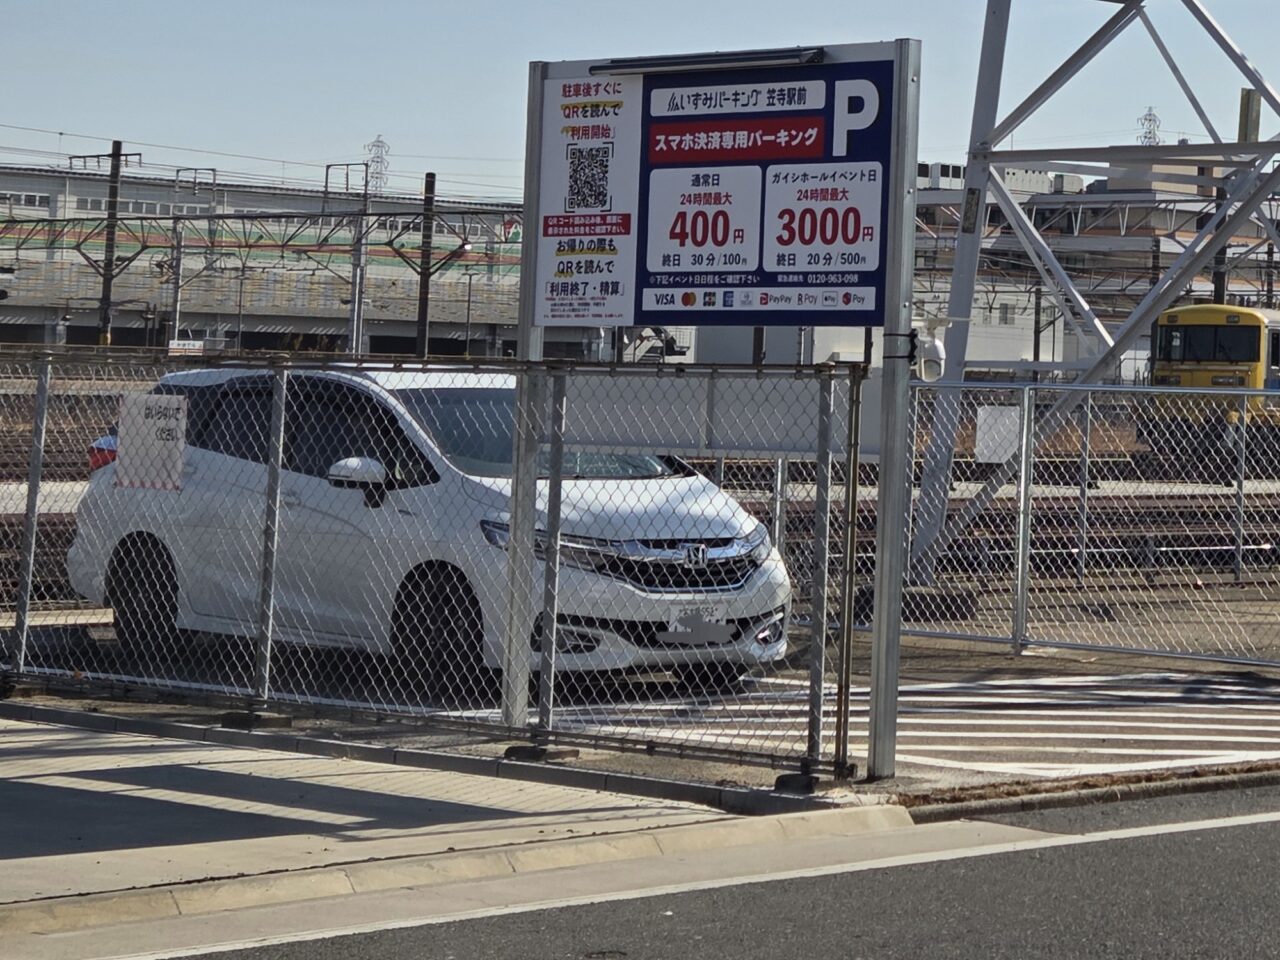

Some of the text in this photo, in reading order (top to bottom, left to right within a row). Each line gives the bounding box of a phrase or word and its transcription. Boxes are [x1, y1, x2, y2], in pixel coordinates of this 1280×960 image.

[562, 82, 622, 98] 駐車後すぐに
[680, 86, 807, 110] いずみパーキング 笠寺駅前
[563, 104, 620, 118] QRを読んで
[832, 79, 880, 157] P
[655, 127, 818, 151] スマホ決済専用パーキング
[691, 174, 720, 187] 通常日
[772, 169, 877, 184] ガイシホールイベント日
[680, 192, 732, 206] 24時間最大
[796, 188, 849, 202] 24時間最大
[557, 238, 617, 253] お帰りの際も
[662, 253, 681, 267] 終日
[776, 253, 796, 266] 終日
[557, 260, 615, 274] QRを読んで
[654, 293, 675, 306] VISA
[769, 294, 792, 305] PayPay
